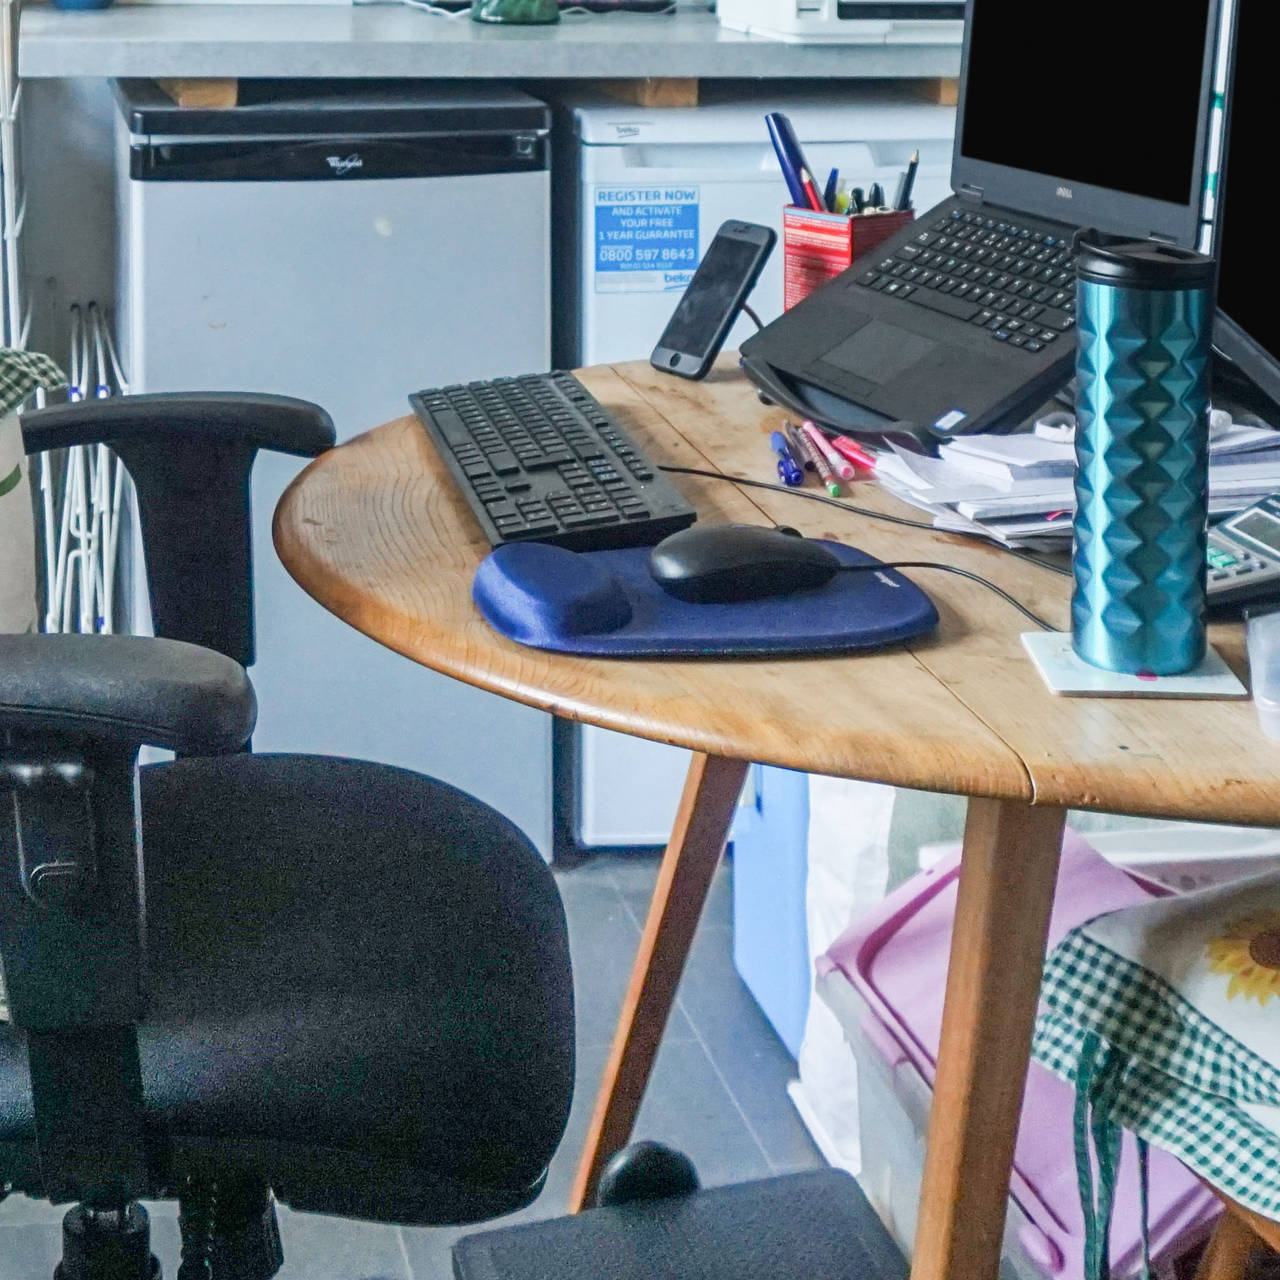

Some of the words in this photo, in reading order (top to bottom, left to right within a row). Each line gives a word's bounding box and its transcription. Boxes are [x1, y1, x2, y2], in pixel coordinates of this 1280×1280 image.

[325, 155, 363, 169] Whirlpool
[598, 191, 661, 202] REGISTER
[664, 190, 697, 201] NOW
[611, 207, 634, 216] AND
[635, 206, 683, 215] ACTIVATE
[620, 219, 648, 227] YOUR
[649, 218, 674, 227] FREE
[599, 232, 605, 240] 1
[607, 231, 634, 240] YEAR
[635, 230, 695, 239] GUARANTEE
[599, 250, 632, 261] 0800
[635, 249, 660, 260] 597
